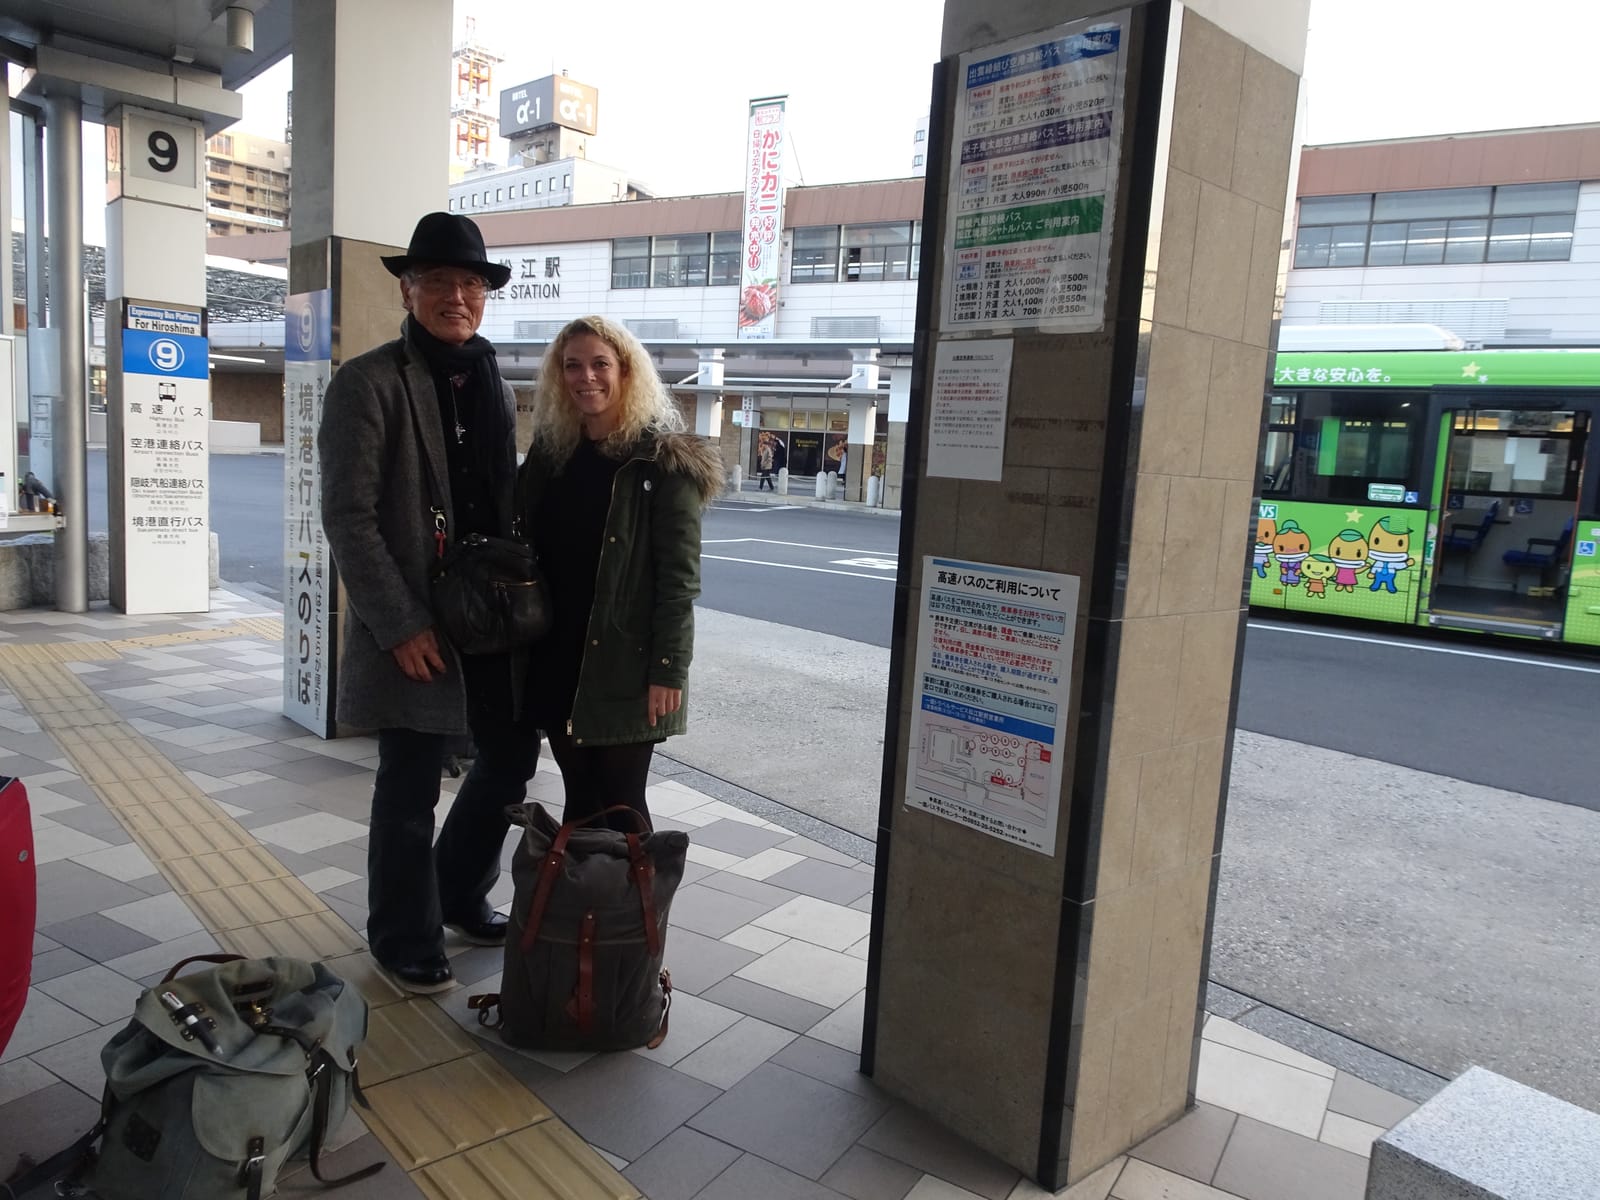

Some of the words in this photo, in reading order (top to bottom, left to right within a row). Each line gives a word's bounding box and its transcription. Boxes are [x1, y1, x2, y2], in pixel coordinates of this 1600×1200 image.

[512, 89, 528, 101] HOTEL
[1056, 117, 1104, 136] ご利用案内
[147, 131, 178, 172] 9
[1011, 188, 1046, 201] 大人990円
[1052, 181, 1089, 195] 小児500円
[1035, 214, 1080, 229] ご利用案内
[986, 279, 1000, 289] 片道
[1004, 276, 1045, 287] 大人1,000円
[1051, 272, 1088, 283] 小児500円
[510, 283, 560, 299] STATION
[985, 289, 999, 299] 片道
[1003, 286, 1044, 297] 大人1,000円
[1050, 283, 1087, 294] 小児500円
[984, 299, 998, 308] 片道
[1002, 296, 1043, 307] 大人1,100円
[1049, 293, 1087, 304] 小児550円
[983, 309, 998, 318] 片道
[1001, 308, 1016, 317] 大人
[1022, 307, 1042, 316] 700円
[1048, 303, 1085, 314] 小児350円
[135, 318, 149, 329] For
[151, 320, 195, 334] Hiroshima
[1274, 367, 1391, 383] 大きな安心を。
[130, 402, 204, 417] 高速バス
[130, 438, 204, 451] 空港連絡バス
[132, 516, 204, 528] 境港直行バス
[298, 383, 315, 705] 境港行バスのりば
[936, 570, 1061, 601] 高速バスのご利用について
